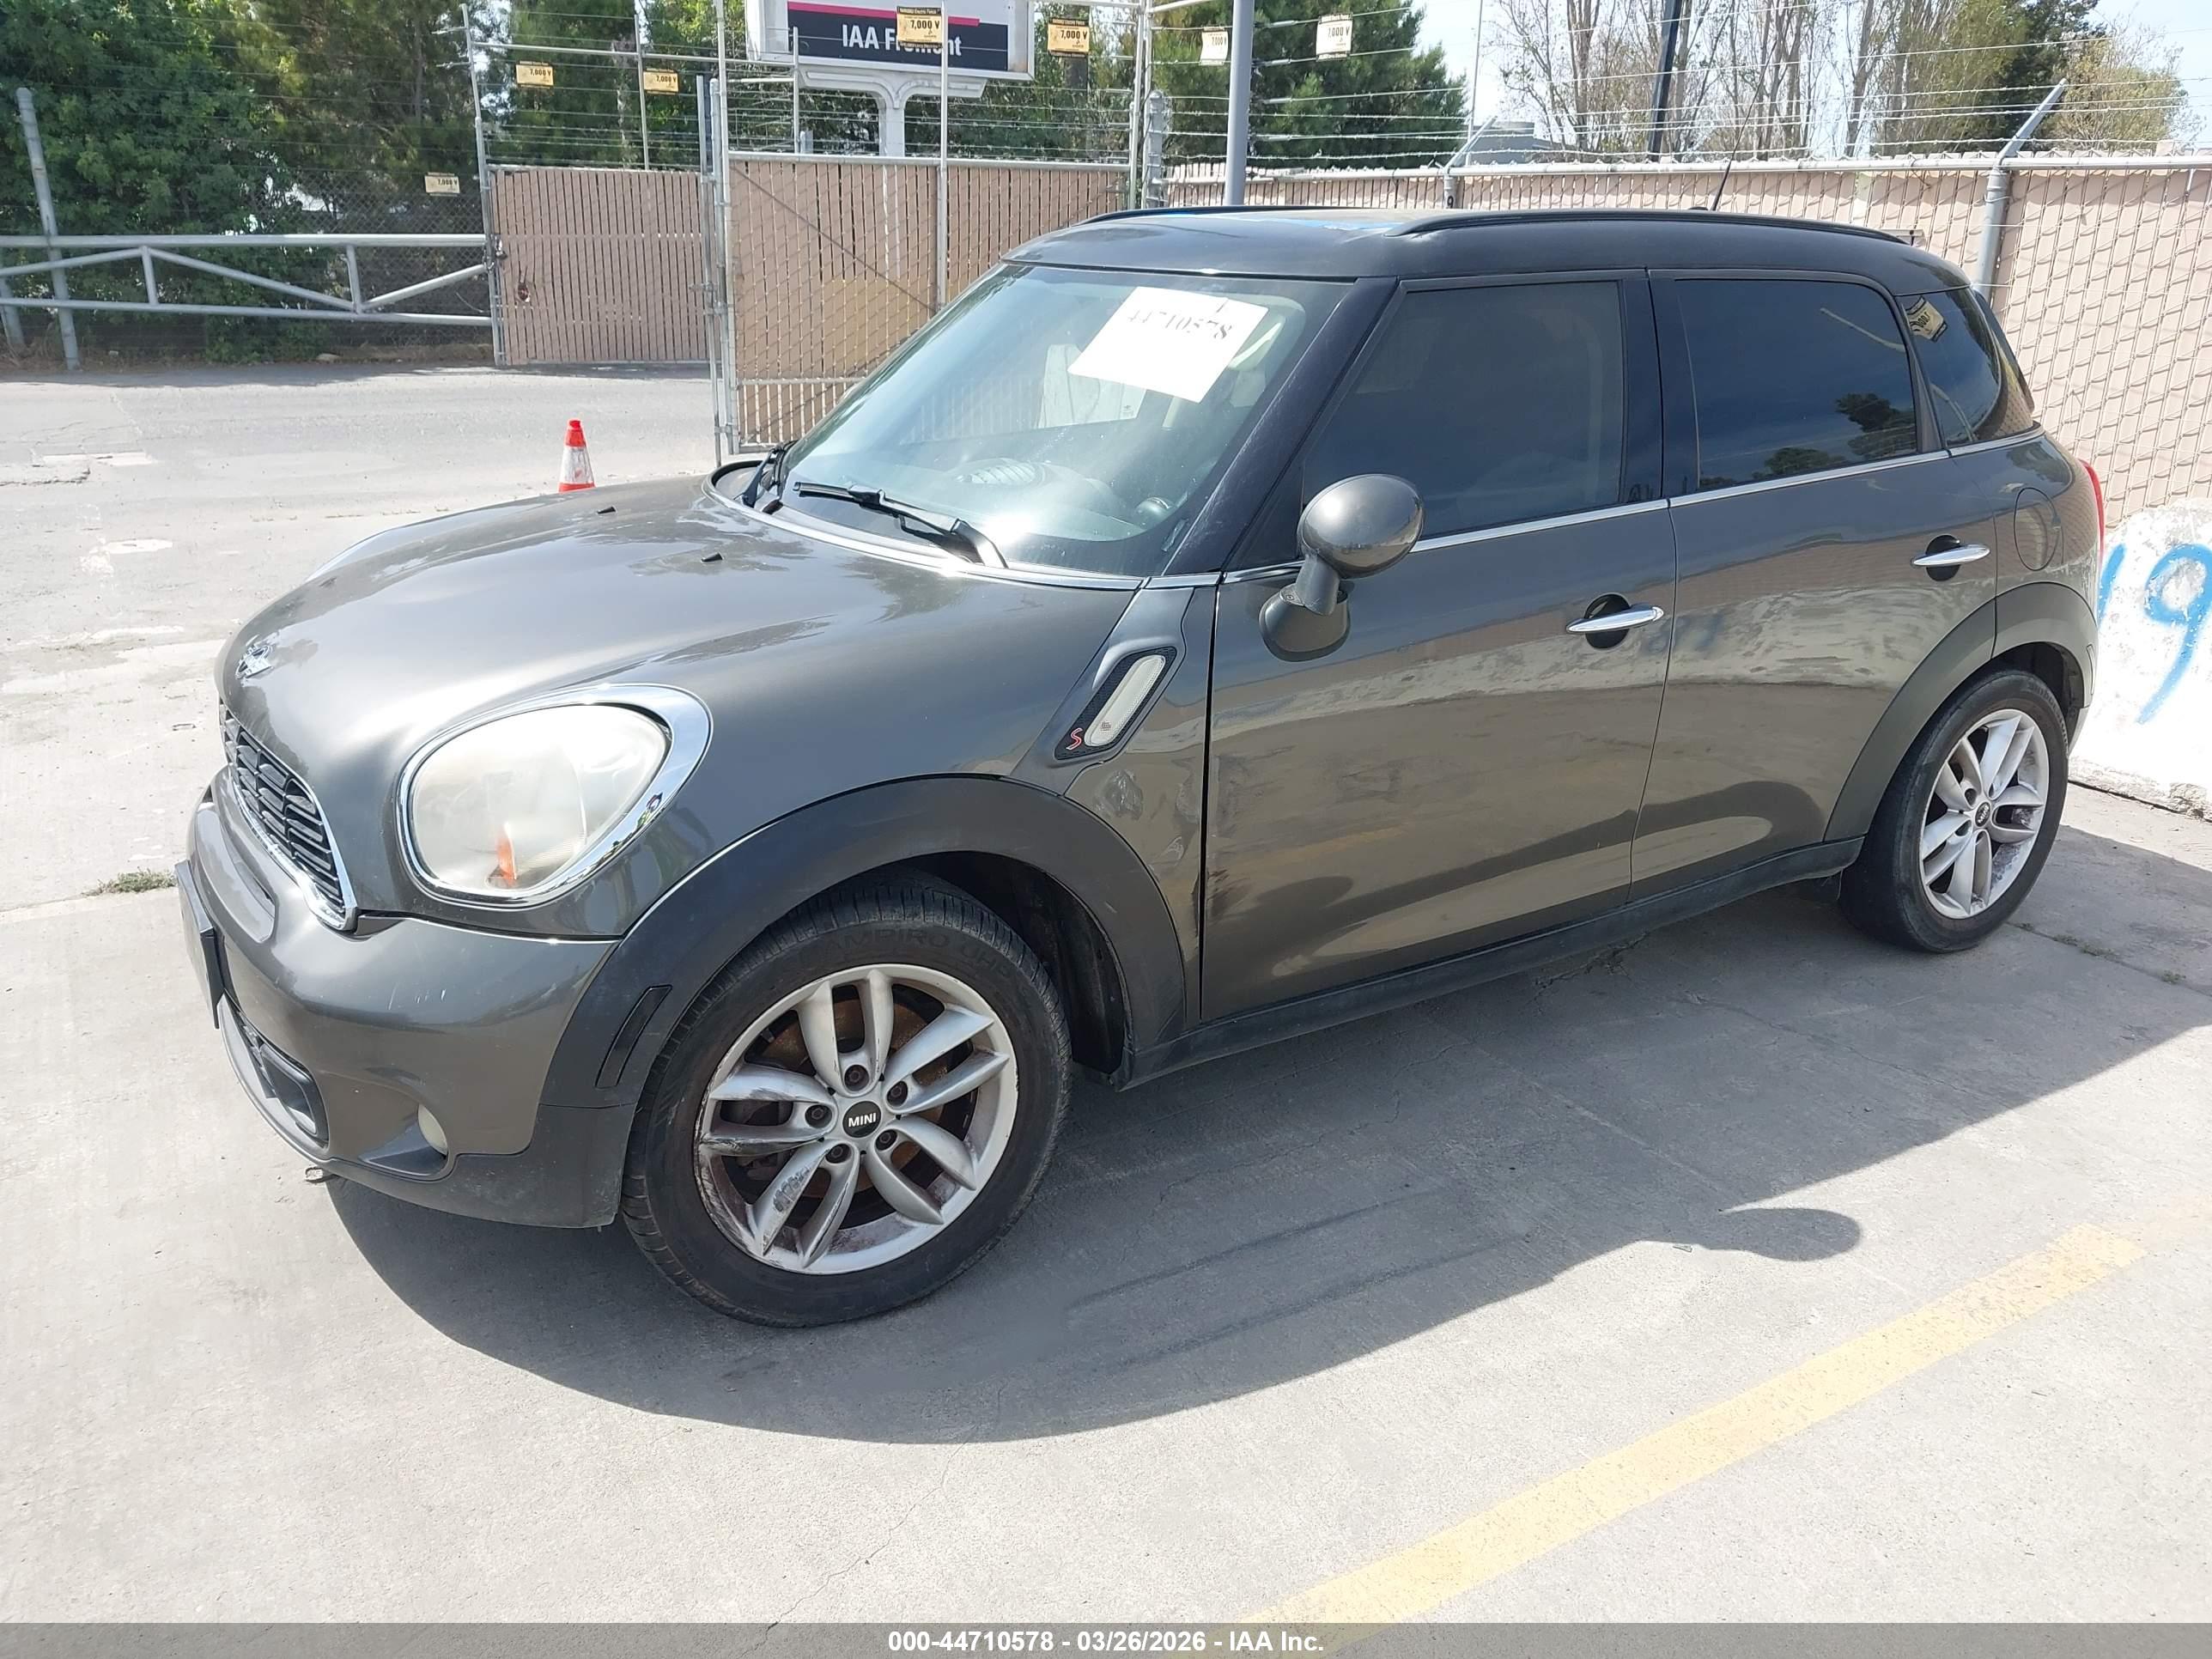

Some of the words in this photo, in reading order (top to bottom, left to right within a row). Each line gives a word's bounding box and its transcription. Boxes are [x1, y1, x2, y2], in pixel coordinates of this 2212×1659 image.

[910, 20, 933, 30] 7,000
[934, 21, 940, 29] V
[1060, 30, 1081, 40] 7,000
[1083, 31, 1088, 40] V
[1346, 26, 1351, 36] V
[842, 23, 880, 50] IAA
[530, 68, 546, 76] 7,000
[1066, 727, 1084, 750] S
[848, 1112, 877, 1127] MINI
